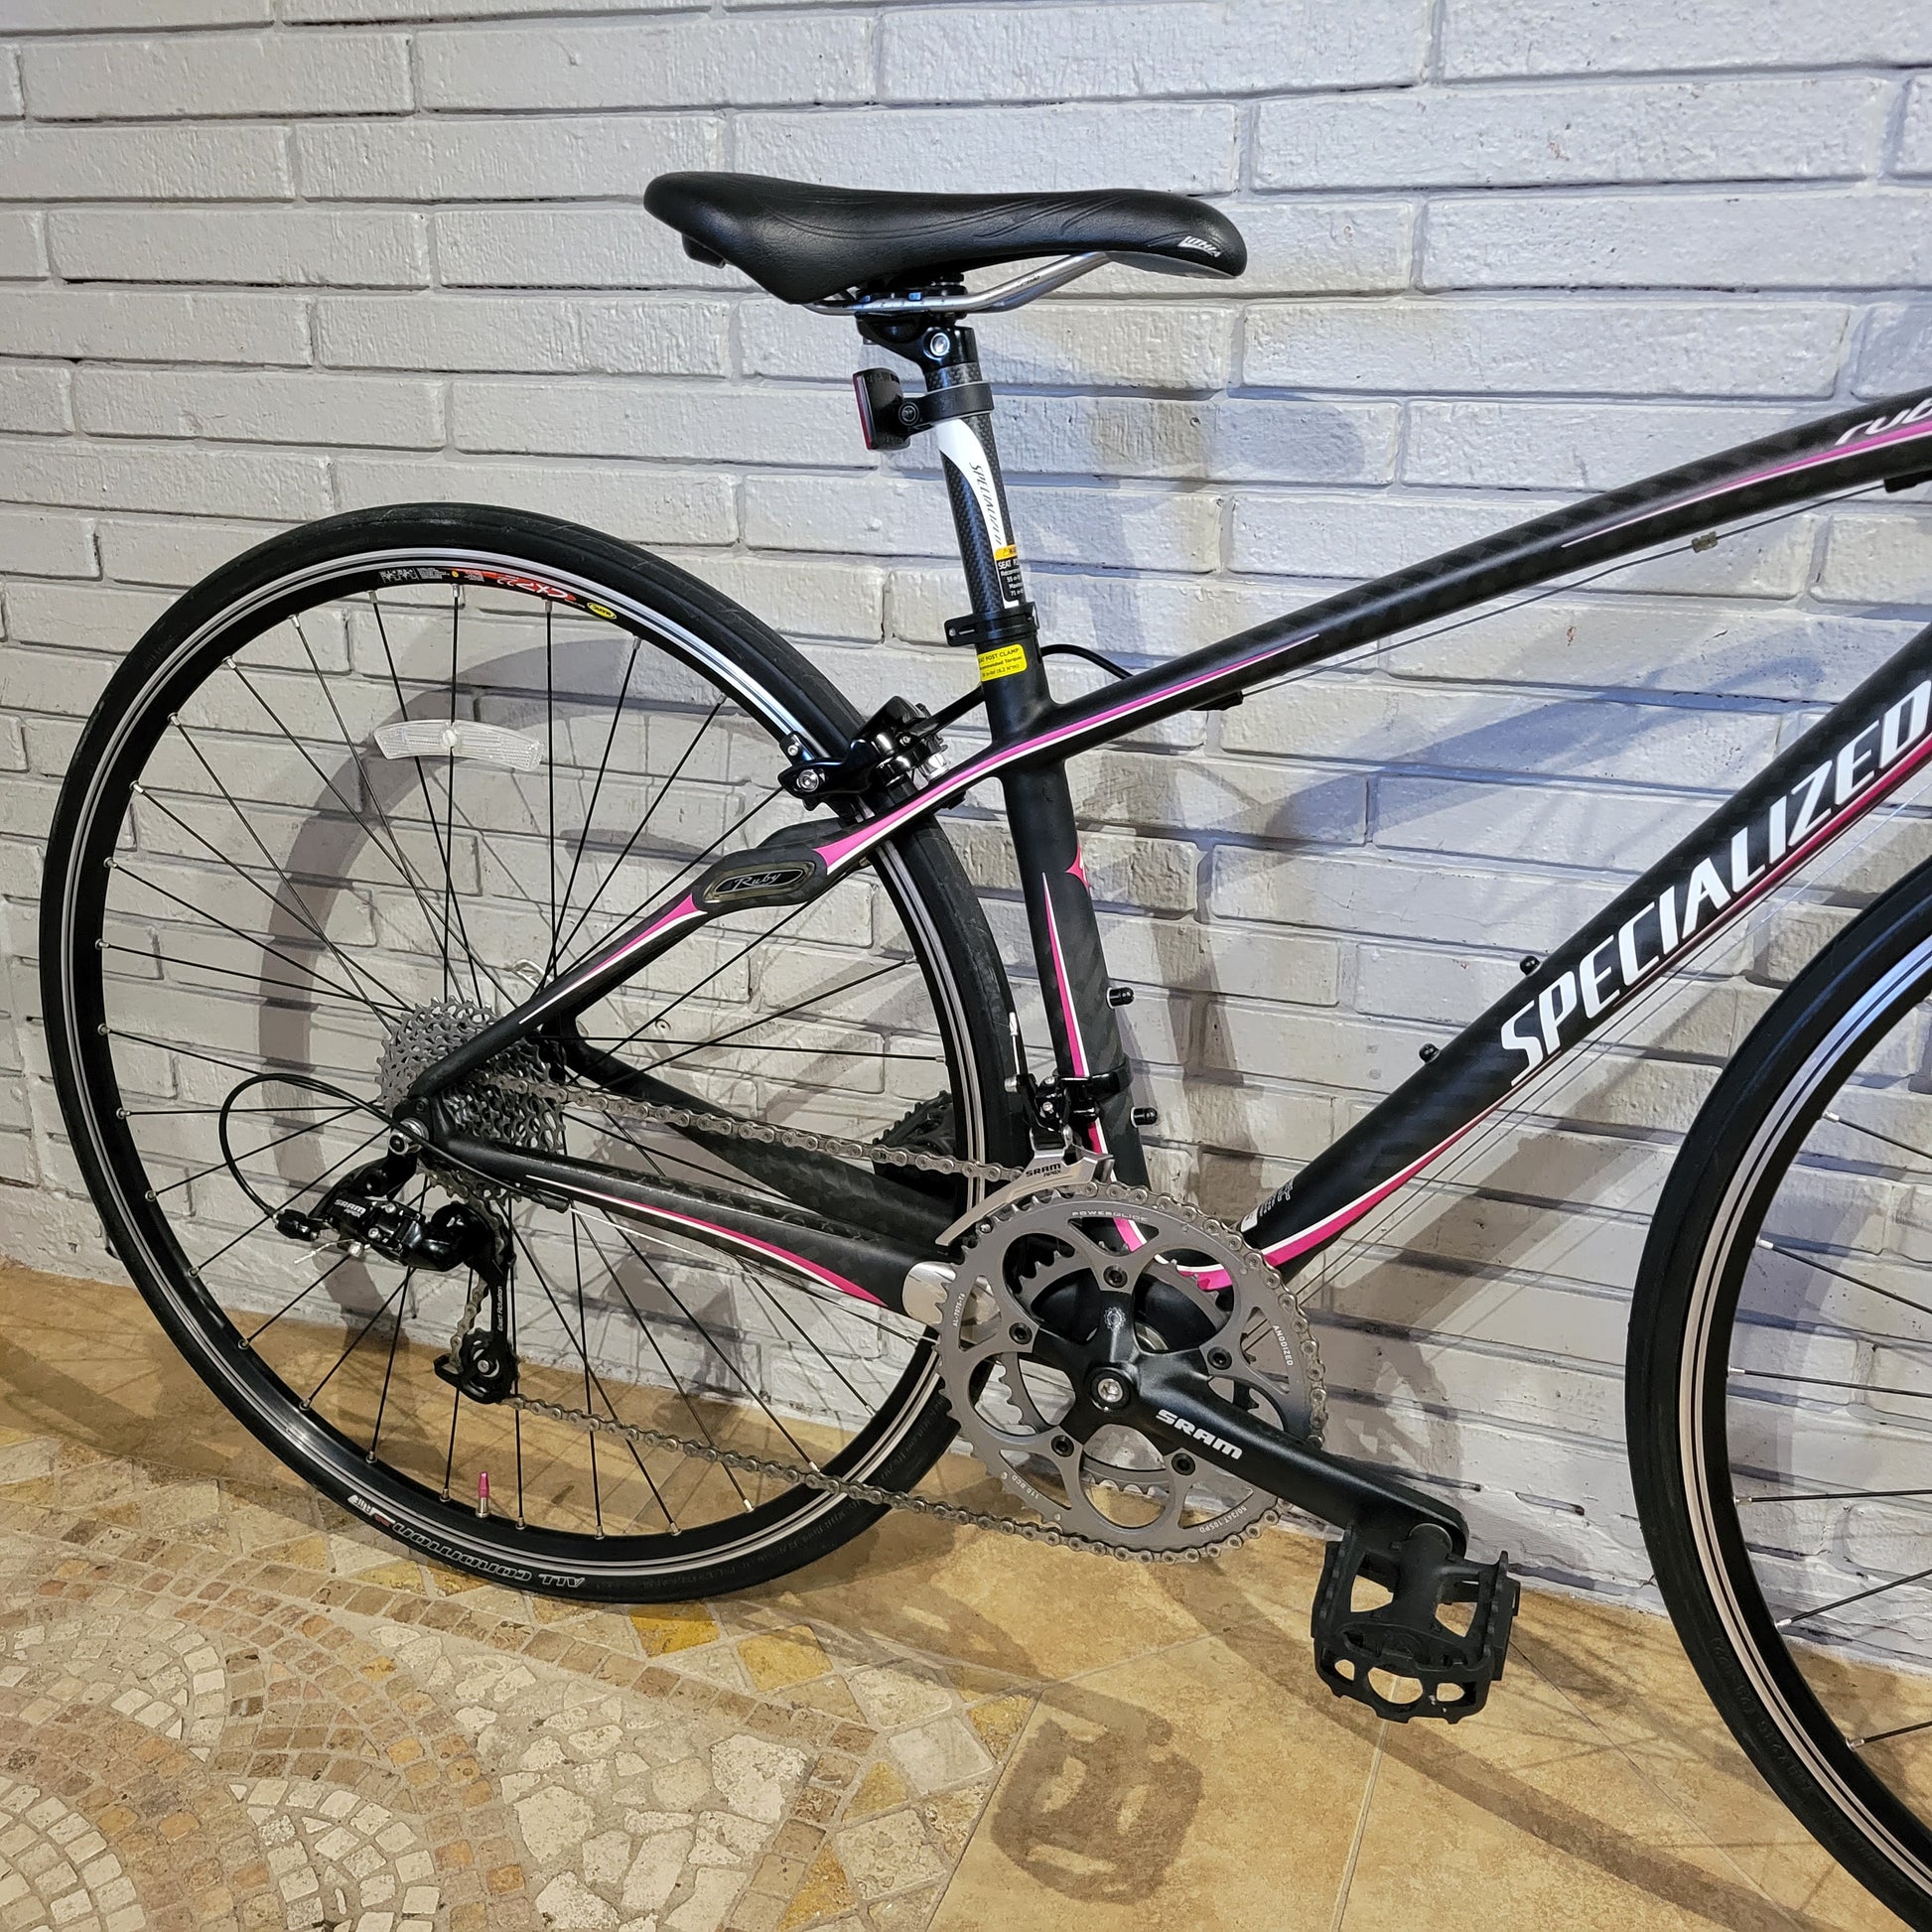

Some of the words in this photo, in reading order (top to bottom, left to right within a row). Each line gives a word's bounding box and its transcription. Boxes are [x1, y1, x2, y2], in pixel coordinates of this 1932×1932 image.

[999, 647, 1020, 657] CLAMP
[733, 873, 781, 891] Ruby
[1501, 679, 1932, 1087] SPECIALIZED
[1026, 1163, 1061, 1177] SRAM
[334, 1198, 366, 1215] SRAM
[1072, 1210, 1149, 1223] POWERGLIDE
[1272, 1324, 1294, 1366] ANODIZED
[1155, 1409, 1243, 1460] SRAM
[538, 1574, 586, 1588] ALL
